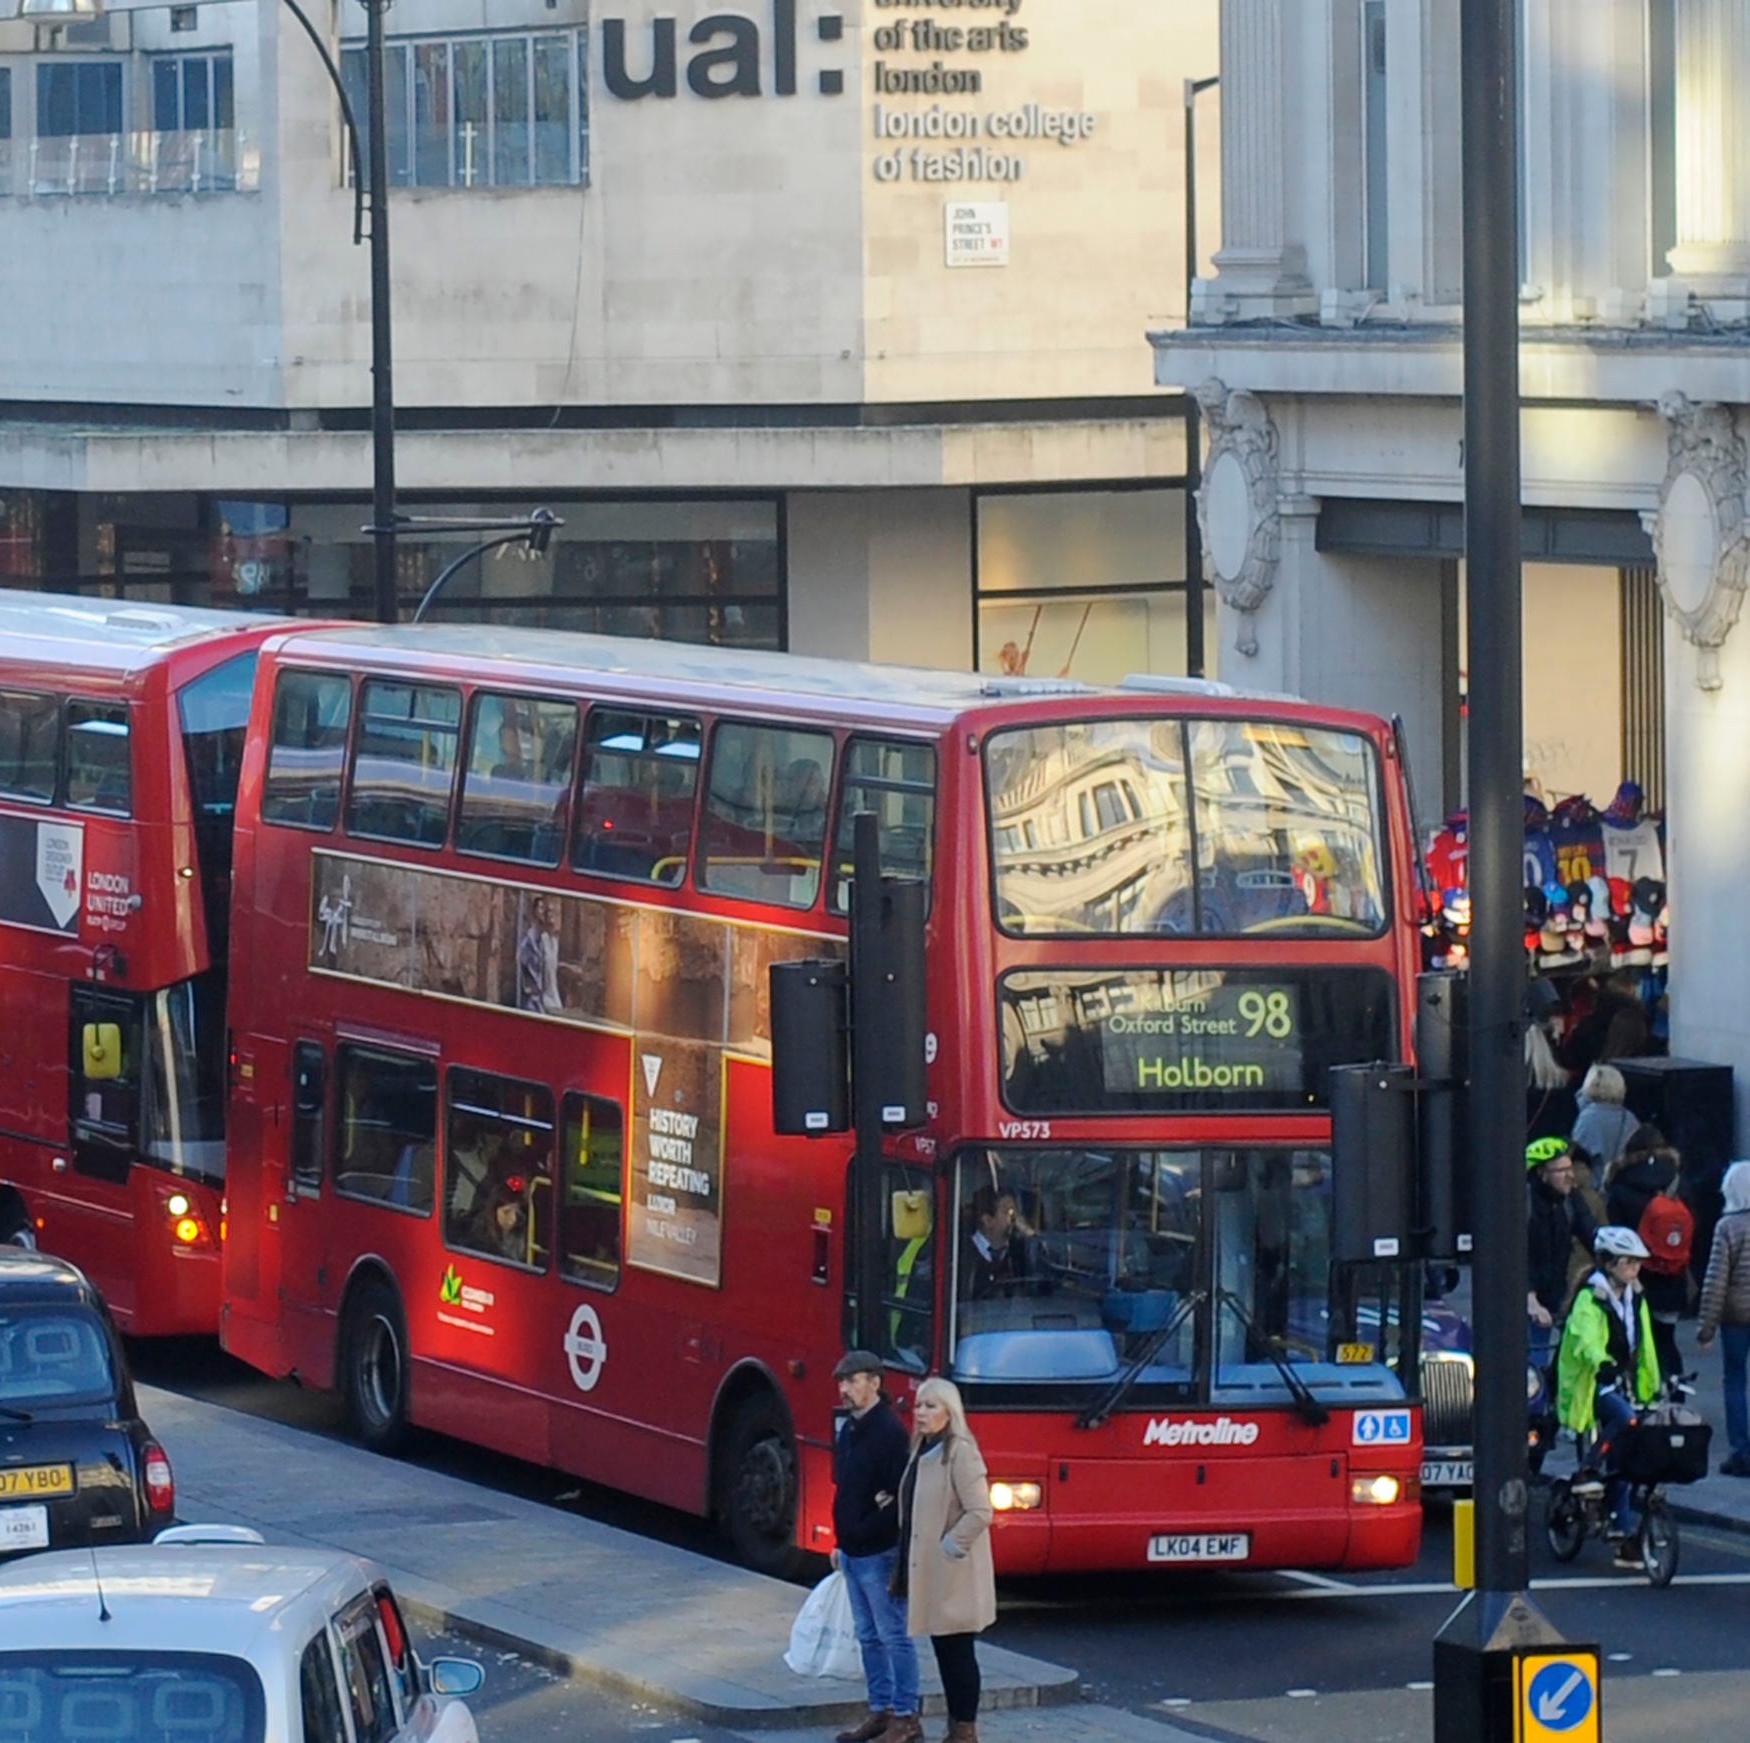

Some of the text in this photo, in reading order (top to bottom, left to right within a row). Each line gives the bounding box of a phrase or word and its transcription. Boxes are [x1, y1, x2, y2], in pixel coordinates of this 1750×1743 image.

[602, 0, 844, 99] ual:
[873, 18, 1029, 51] of the arts
[873, 61, 982, 94] london
[873, 104, 1097, 146] london college
[873, 147, 1023, 182] of fashion
[953, 208, 976, 220] JOHN
[953, 222, 992, 235] PRINCE'S
[953, 238, 985, 251] STREET
[1618, 849, 1638, 881] 7
[87, 871, 130, 894] LONDON
[86, 892, 130, 917] UNITED
[1108, 1014, 1238, 1035] Oxford Street
[1238, 991, 1292, 1039] 98
[1138, 1056, 1264, 1088] Holborn
[649, 1107, 699, 1140] HISTORY
[998, 1120, 1051, 1140] VP573
[648, 1133, 692, 1165] WORTH
[647, 1160, 710, 1197] REPEATING
[1142, 1416, 1259, 1446] Metroline
[27, 1469, 62, 1489] YBO
[1154, 1538, 1201, 1557] LK04
